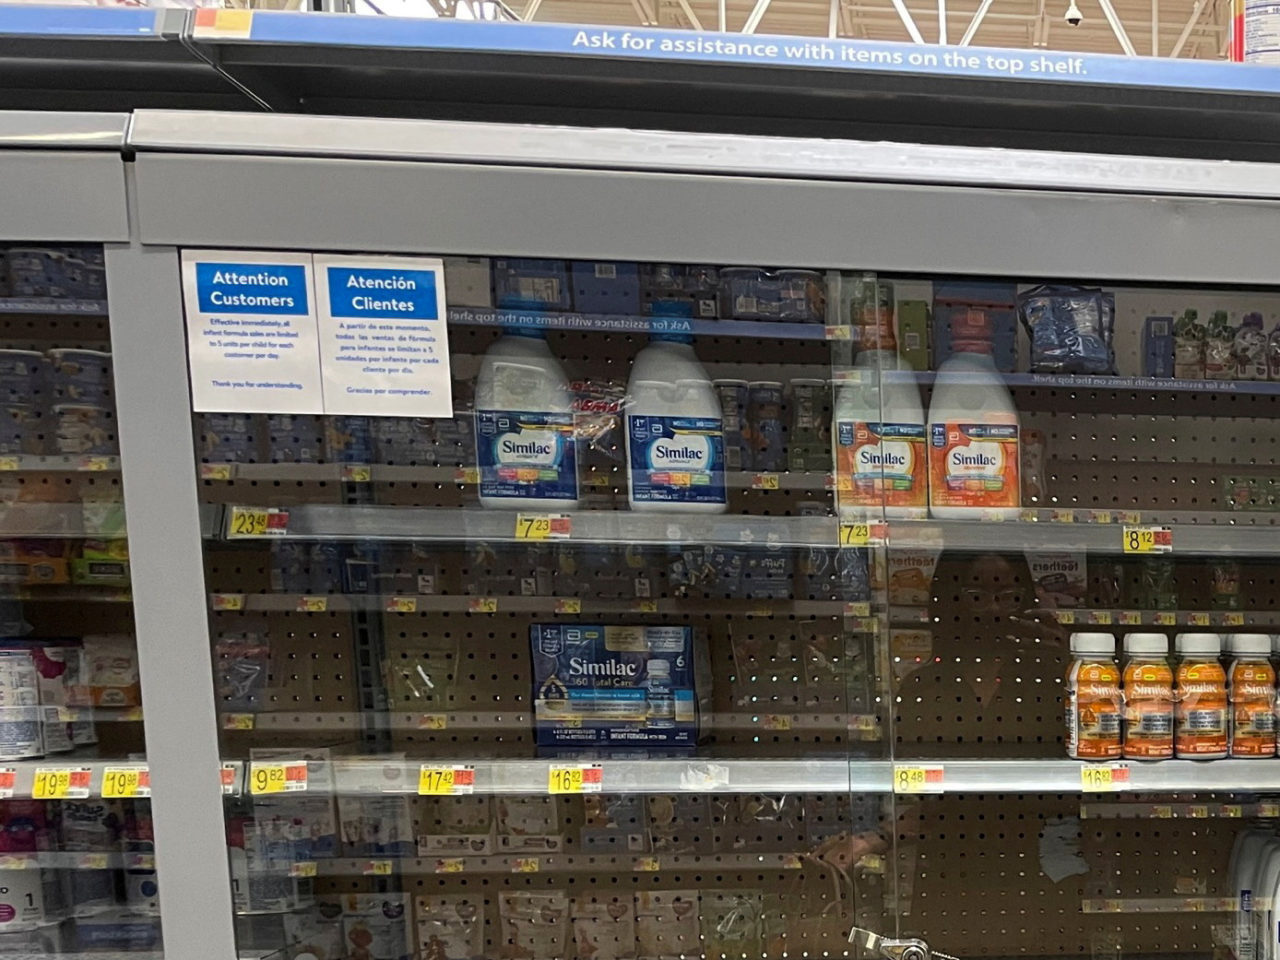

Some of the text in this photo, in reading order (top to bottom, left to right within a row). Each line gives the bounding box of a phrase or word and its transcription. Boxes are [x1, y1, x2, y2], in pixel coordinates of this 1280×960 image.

[572, 31, 1088, 76] Ask for assistance with items on the top shelf.
[212, 271, 288, 286] Attention
[346, 274, 416, 290] Atención
[210, 292, 294, 307] Customers
[352, 296, 414, 312] Clientes
[210, 318, 240, 326] Effective
[502, 440, 550, 455] Similac
[655, 446, 703, 460] Similac
[860, 452, 906, 466] Similac
[952, 452, 996, 466] Similac
[569, 658, 636, 676] Similac
[676, 656, 685, 670] 6
